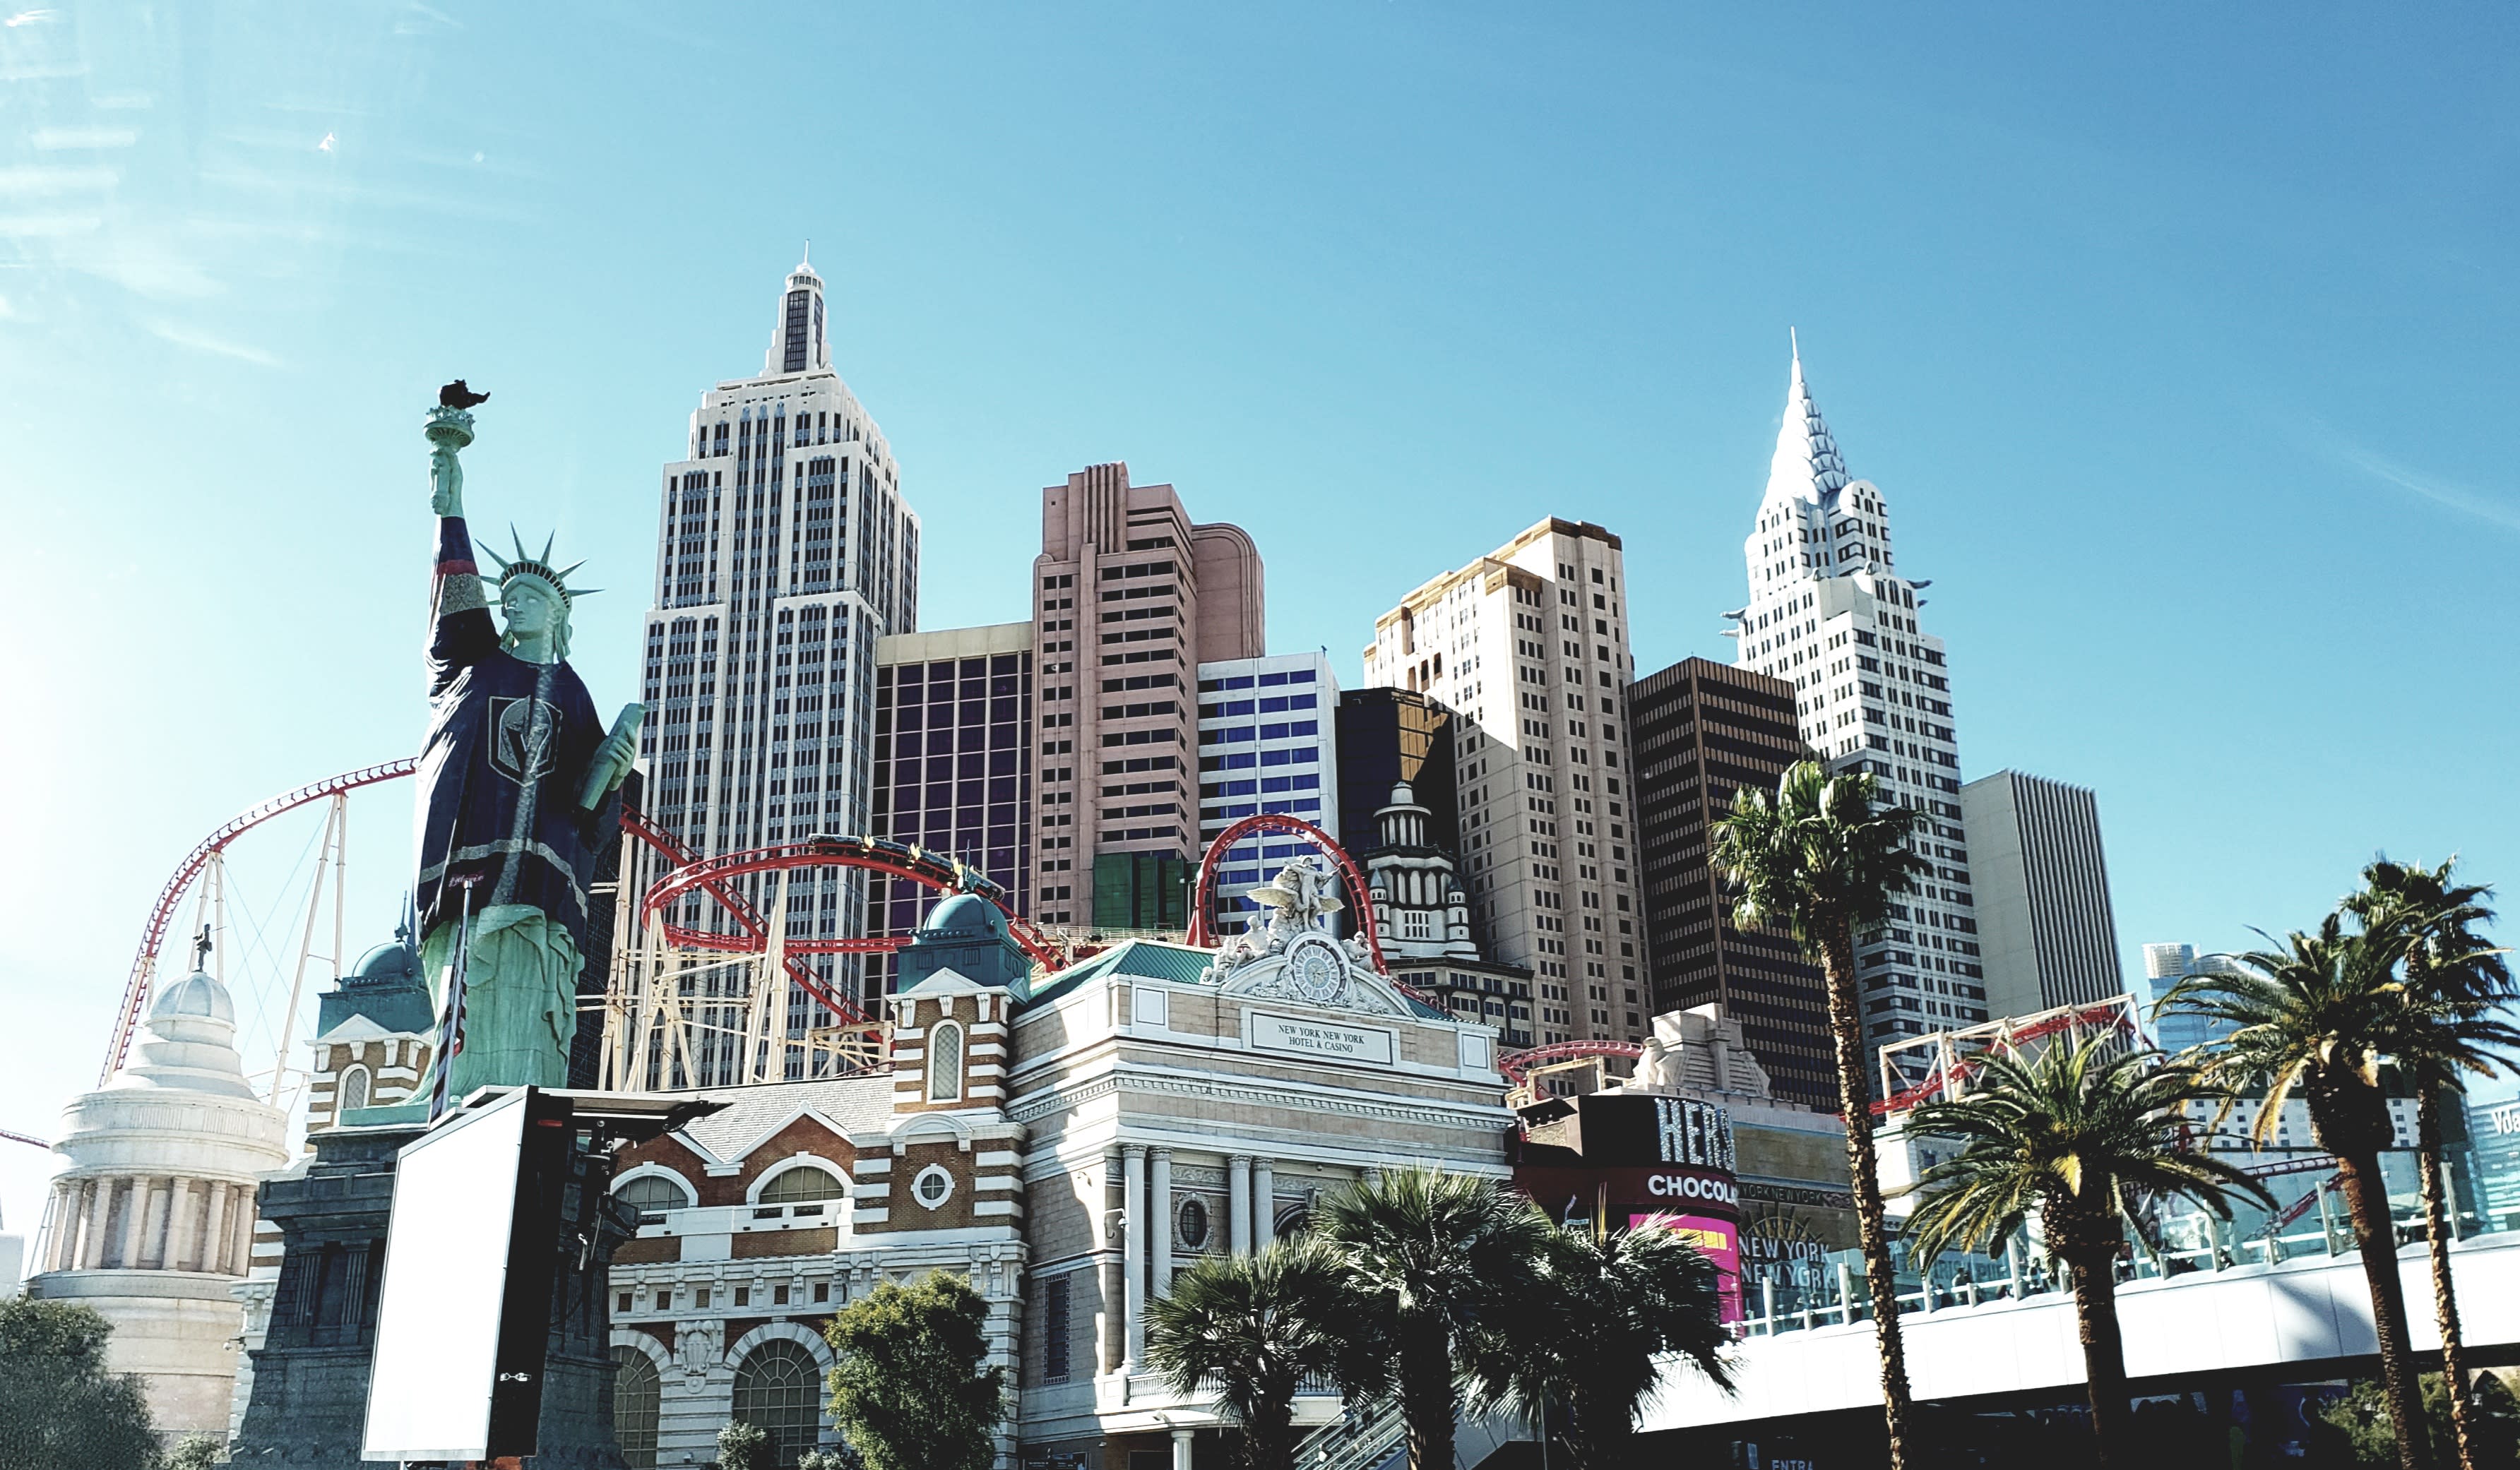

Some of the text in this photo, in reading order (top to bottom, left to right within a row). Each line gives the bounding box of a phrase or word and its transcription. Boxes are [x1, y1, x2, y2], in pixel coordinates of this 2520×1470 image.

[1278, 1024, 1365, 1044] NEW YORK NEW YORK
[1289, 1036, 1353, 1053] HOTEL & CASINO
[1738, 1236, 1778, 1258] NEW
[1783, 1239, 1829, 1262] YORK
[1740, 1262, 1836, 1290] NEW YORK
